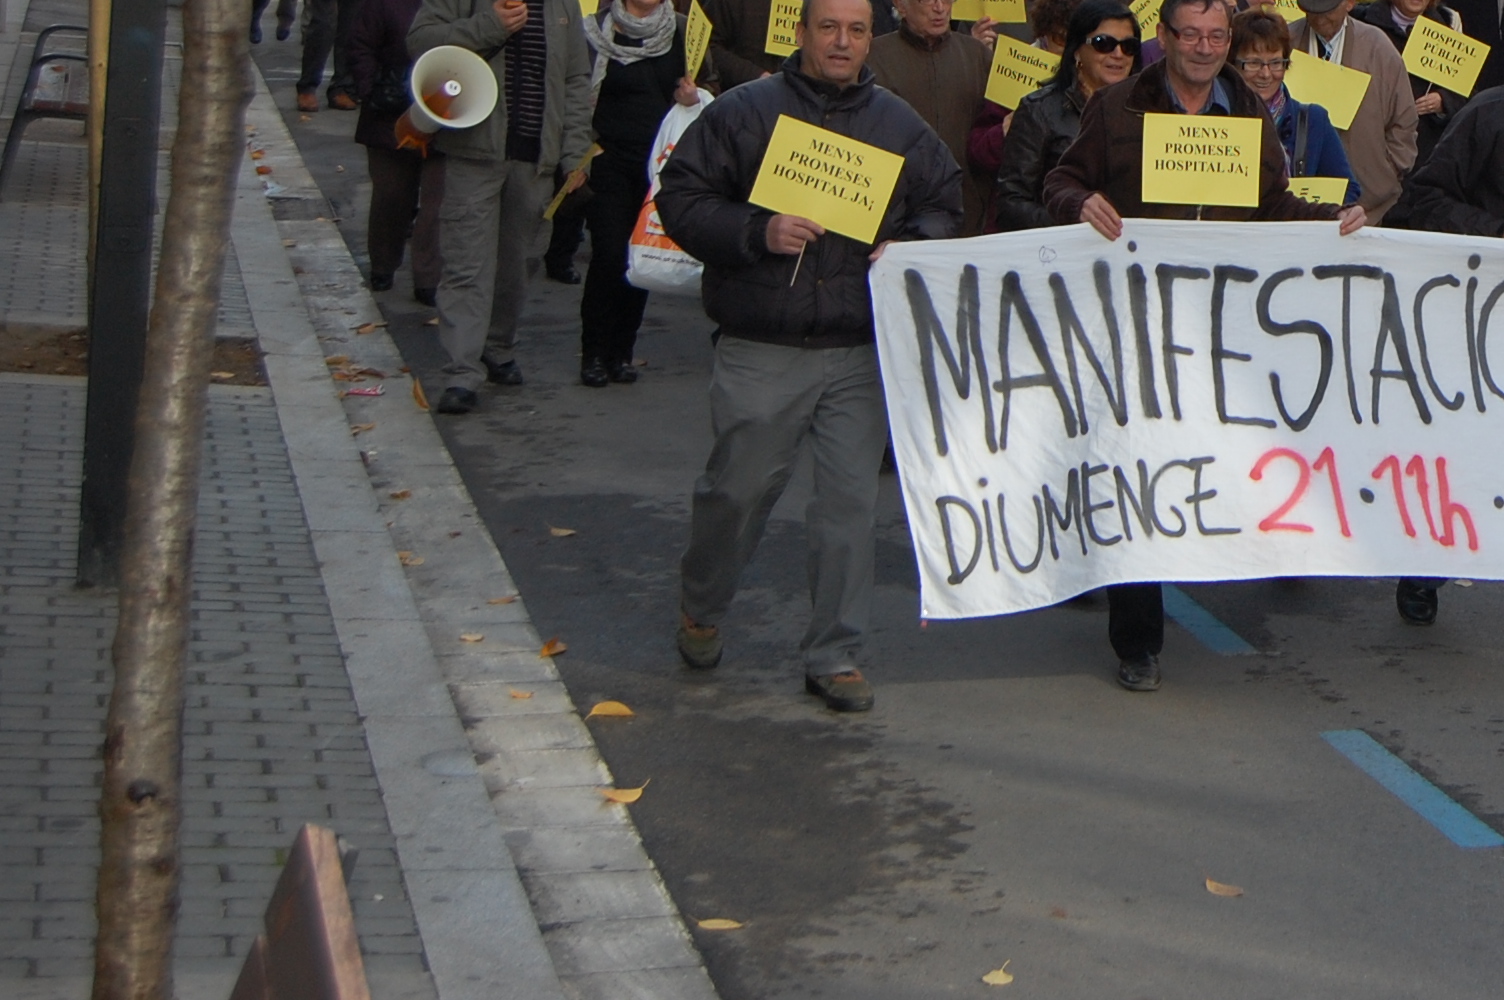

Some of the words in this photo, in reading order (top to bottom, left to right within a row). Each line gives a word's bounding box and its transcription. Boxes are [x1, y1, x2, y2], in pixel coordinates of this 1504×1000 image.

[773, 34, 791, 43] una
[1422, 27, 1477, 58] HOSPITAL
[1008, 47, 1048, 70] Mentides
[1423, 42, 1466, 66] PÚBLIC
[996, 64, 1042, 89] HOSPITA
[1420, 55, 1459, 78] QUAN?
[1178, 126, 1229, 140] MENYS
[808, 139, 864, 167] MENYS
[1165, 143, 1241, 157] PROMESES
[789, 151, 872, 188] PROMESES
[1155, 159, 1225, 174] HOSPITAL
[773, 164, 848, 200] HOSPITAL
